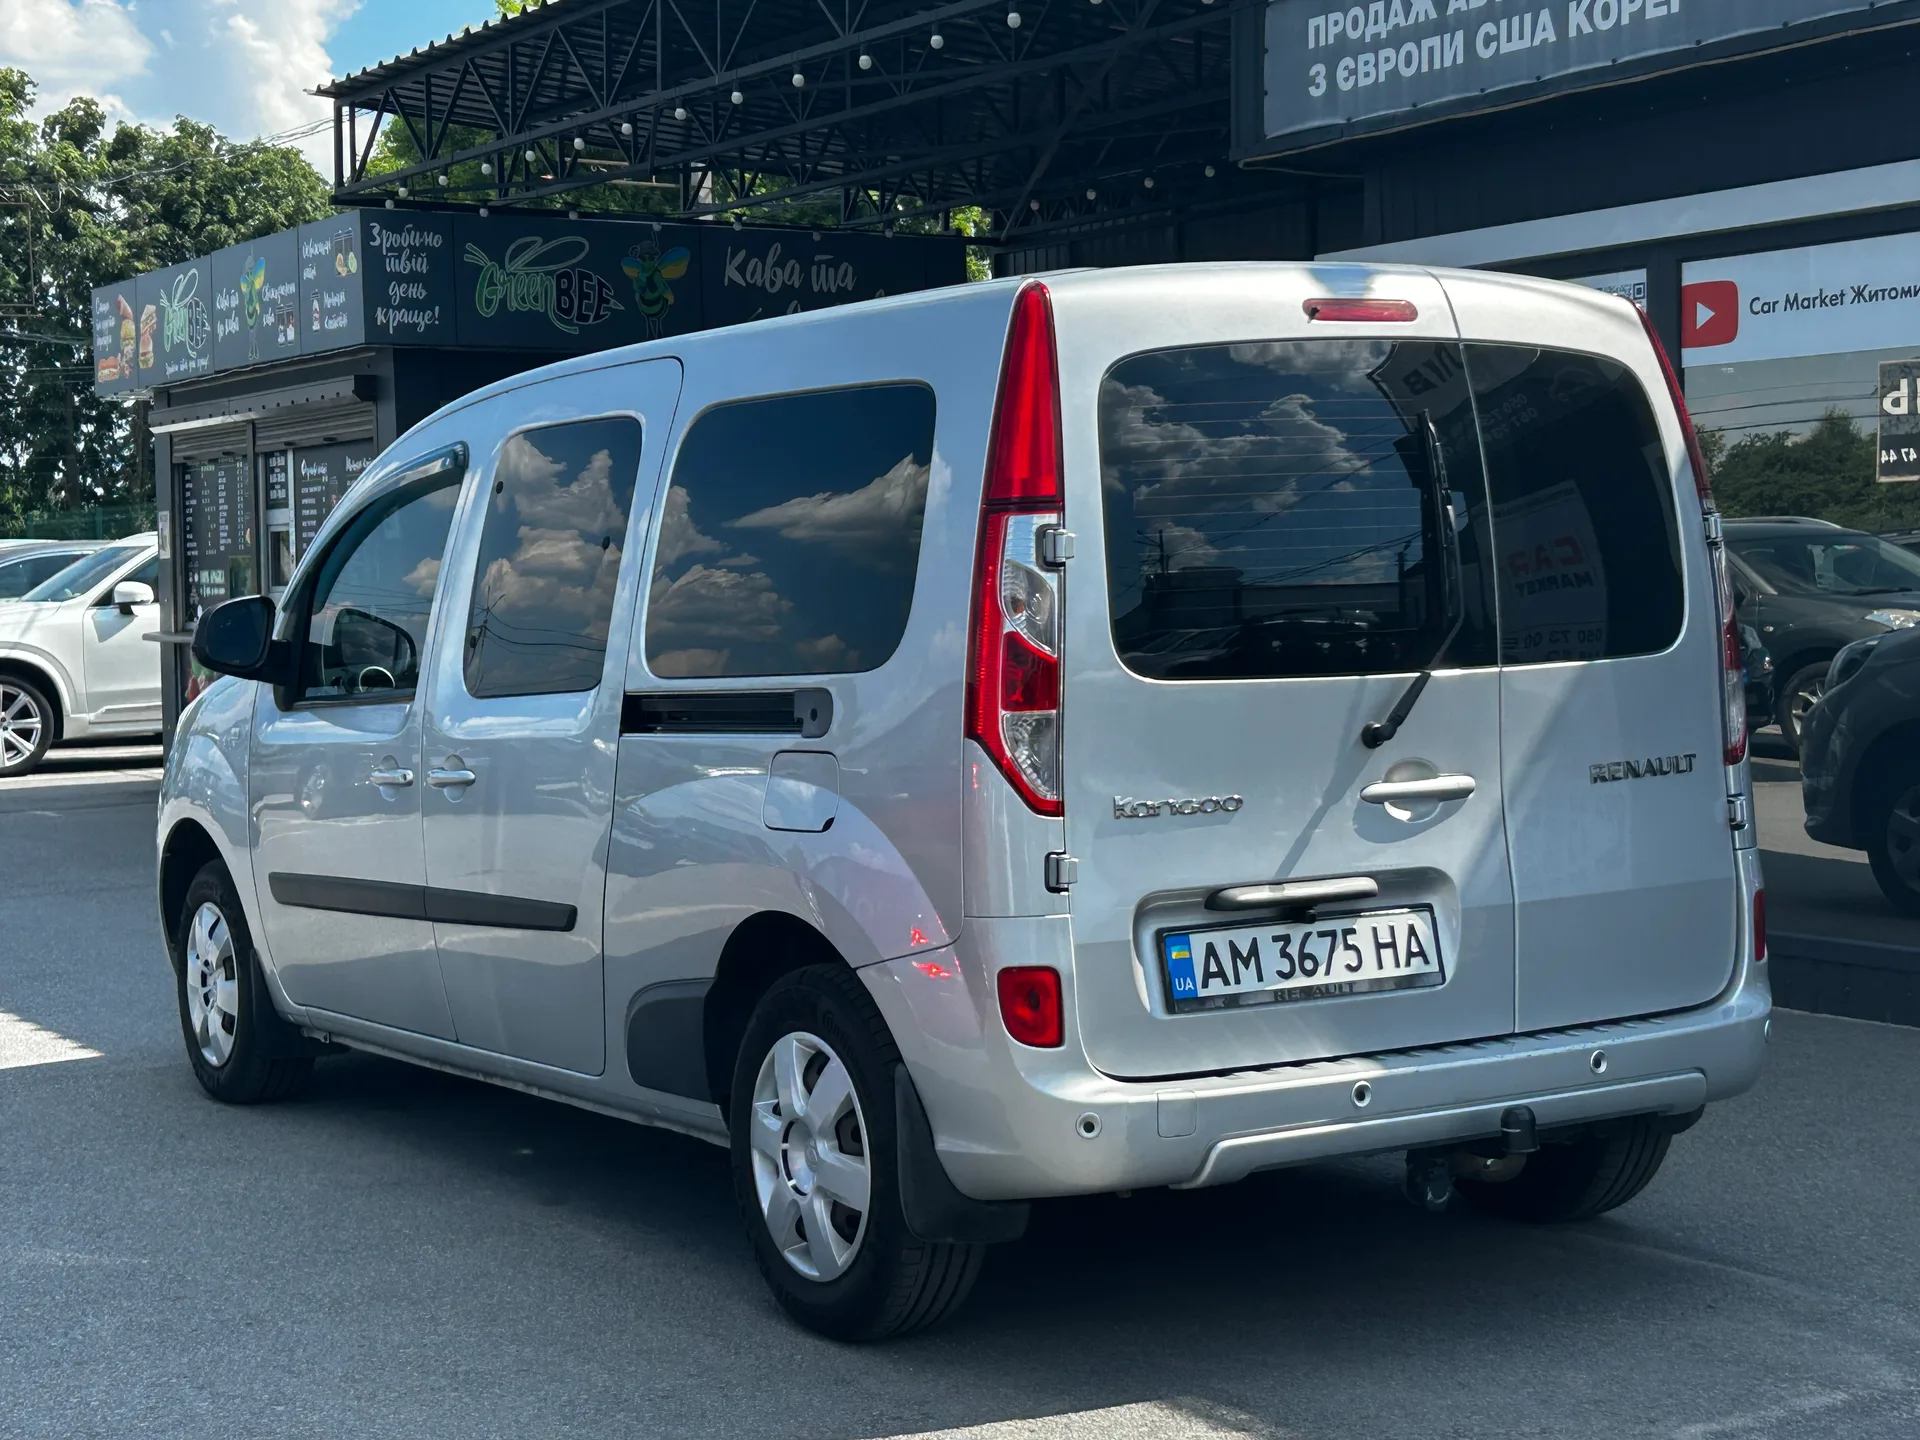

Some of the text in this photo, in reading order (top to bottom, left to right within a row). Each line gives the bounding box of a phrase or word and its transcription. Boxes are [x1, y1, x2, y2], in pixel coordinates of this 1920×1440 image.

[1308, 0, 1438, 49] ПРОДАЖ
[1308, 63, 1327, 97] З
[1336, 29, 1464, 91] ЄВРОПИ
[1475, 8, 1557, 60] США
[385, 248, 430, 274] твій
[723, 242, 858, 294] Кава та
[388, 281, 428, 306] день
[1749, 297, 1780, 315] Car
[1783, 288, 1846, 312] Market
[374, 305, 440, 335] краще!
[1589, 753, 1697, 785] RENAULT
[1201, 920, 1432, 991] AM 3675 HA
[1175, 978, 1196, 993] UA
[1274, 981, 1357, 1002] RENAULT
